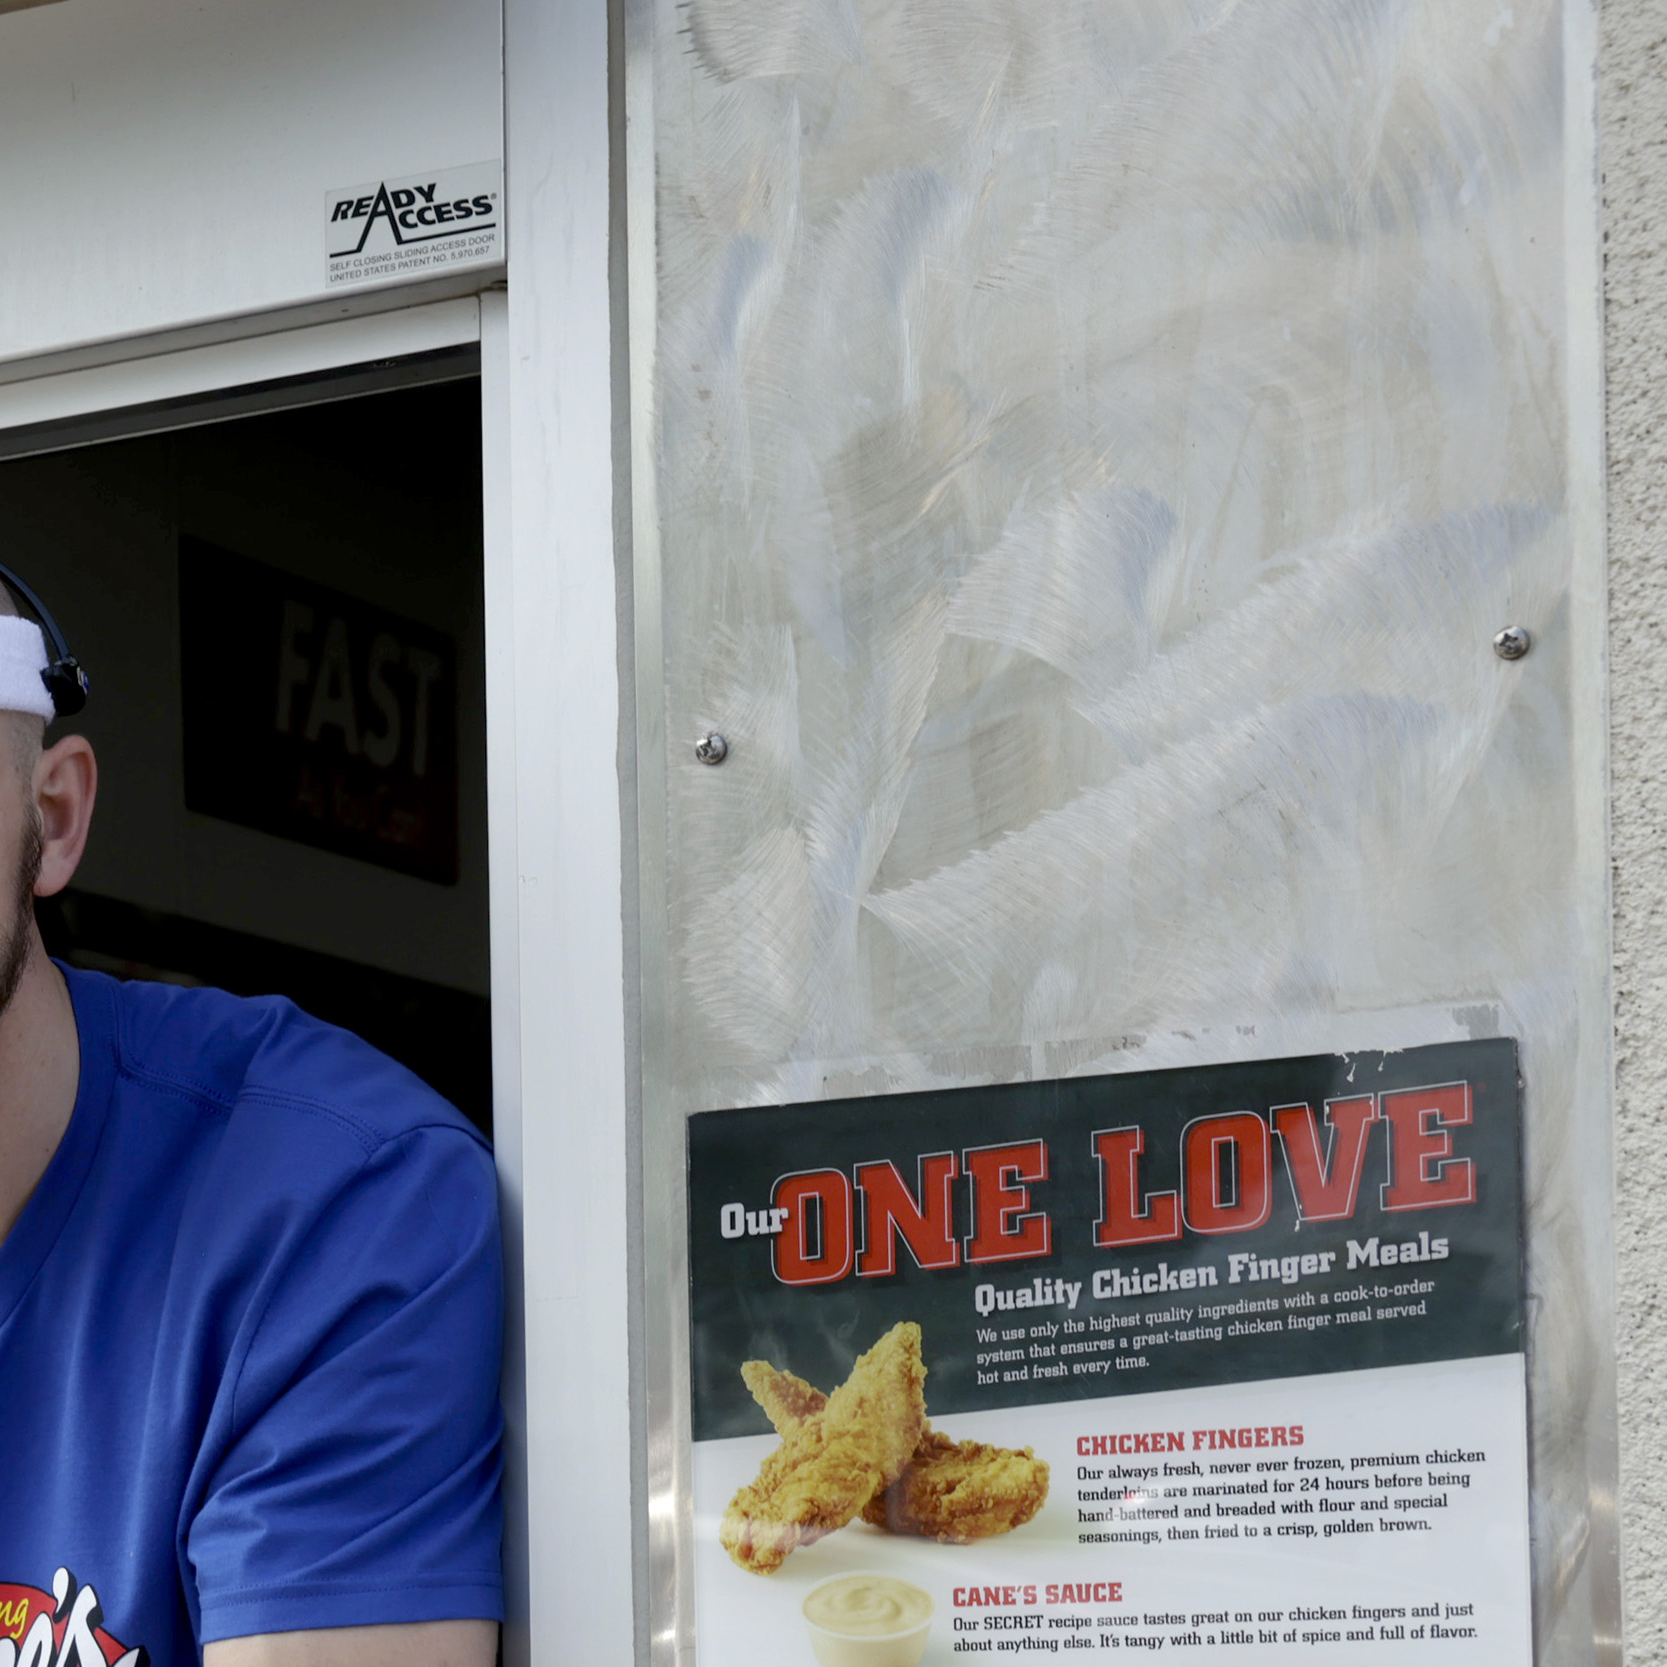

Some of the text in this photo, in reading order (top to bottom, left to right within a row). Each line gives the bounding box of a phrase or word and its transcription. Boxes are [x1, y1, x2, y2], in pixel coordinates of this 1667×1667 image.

[331, 181, 437, 226] READY
[330, 233, 495, 272] SELF CLOSING SLIDING ACCESS DOOR
[330, 245, 490, 283] UNITED STATES PATENT NO. 5,970,657
[275, 598, 441, 776] FAST
[721, 1081, 1478, 1288] Our ONE LOVE
[974, 1231, 1449, 1318] Quality Chicken Finger Meals
[975, 1278, 1435, 1344] We use only the highest quality ingredients with a cook-to-order
[976, 1299, 1427, 1367] system that ensures a great-tasting chicken finger meal served
[977, 1355, 1150, 1385] hot and fresh every time.
[1076, 1425, 1305, 1457] CHICKEN FINGERS
[1077, 1448, 1486, 1481] Our always fresh, never ever frozen, premium chicken
[952, 1582, 1123, 1607] CANE'S SAUCE
[953, 1602, 1474, 1631] Our SECRET recipe sauce tastes great on our chicken fingers and just
